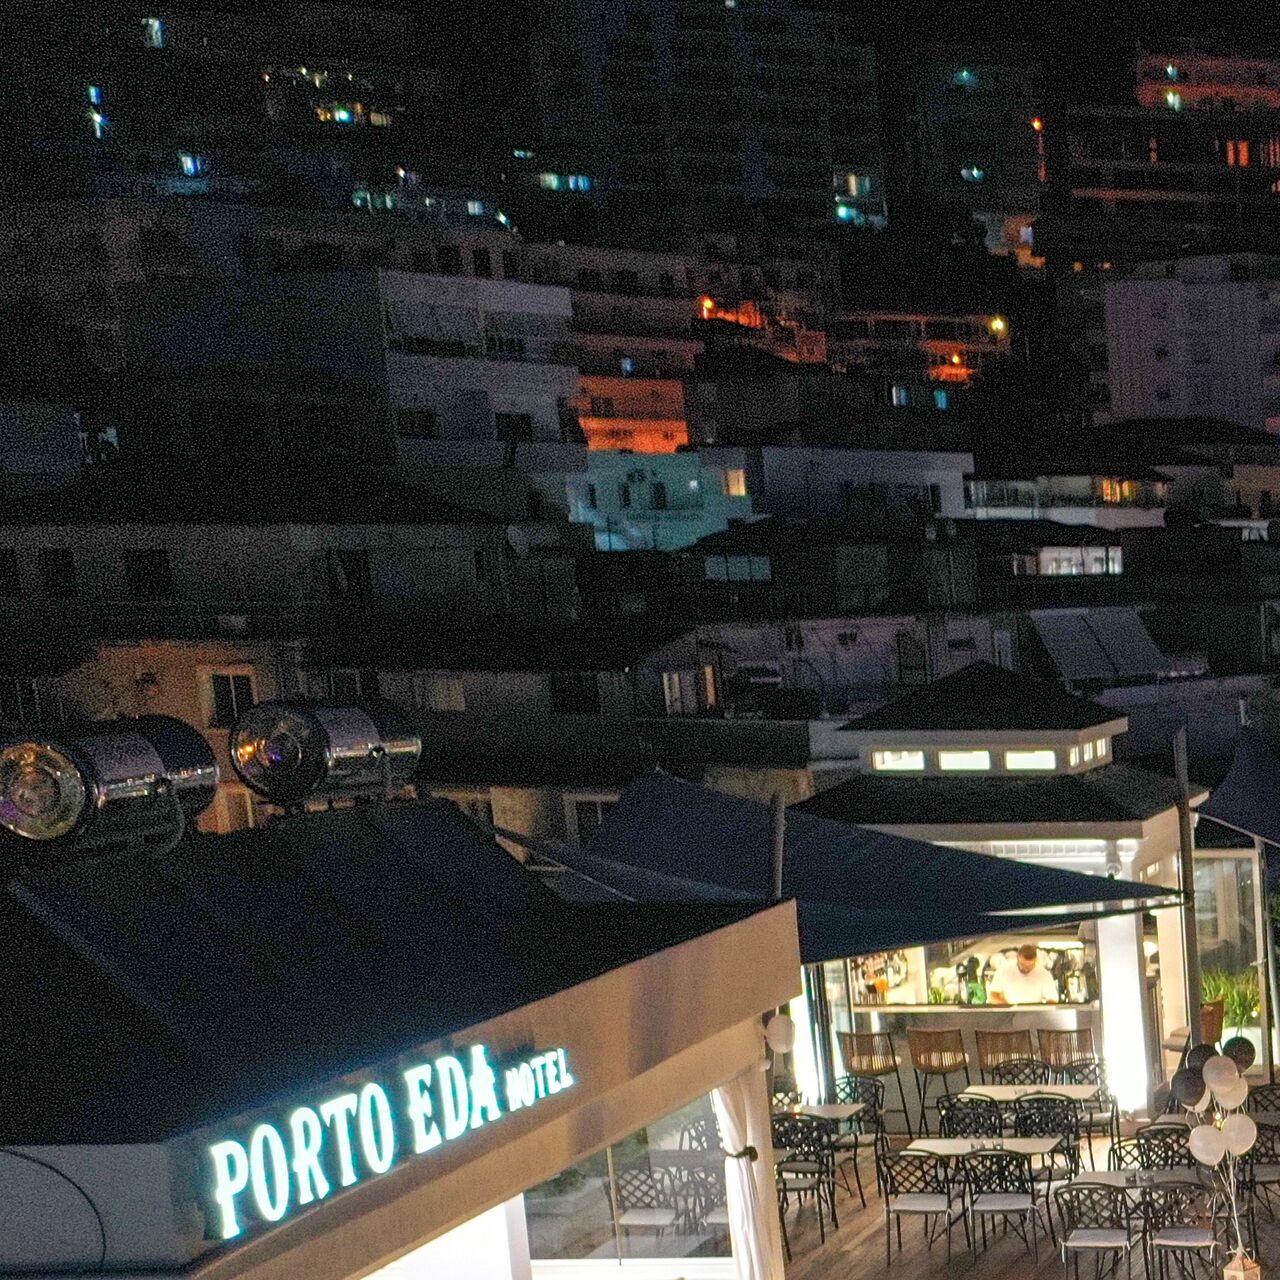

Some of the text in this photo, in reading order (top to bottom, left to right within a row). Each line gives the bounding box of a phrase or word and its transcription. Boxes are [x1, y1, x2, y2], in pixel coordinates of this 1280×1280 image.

[208, 1044, 575, 1240] PORTO EDA HOTEL
